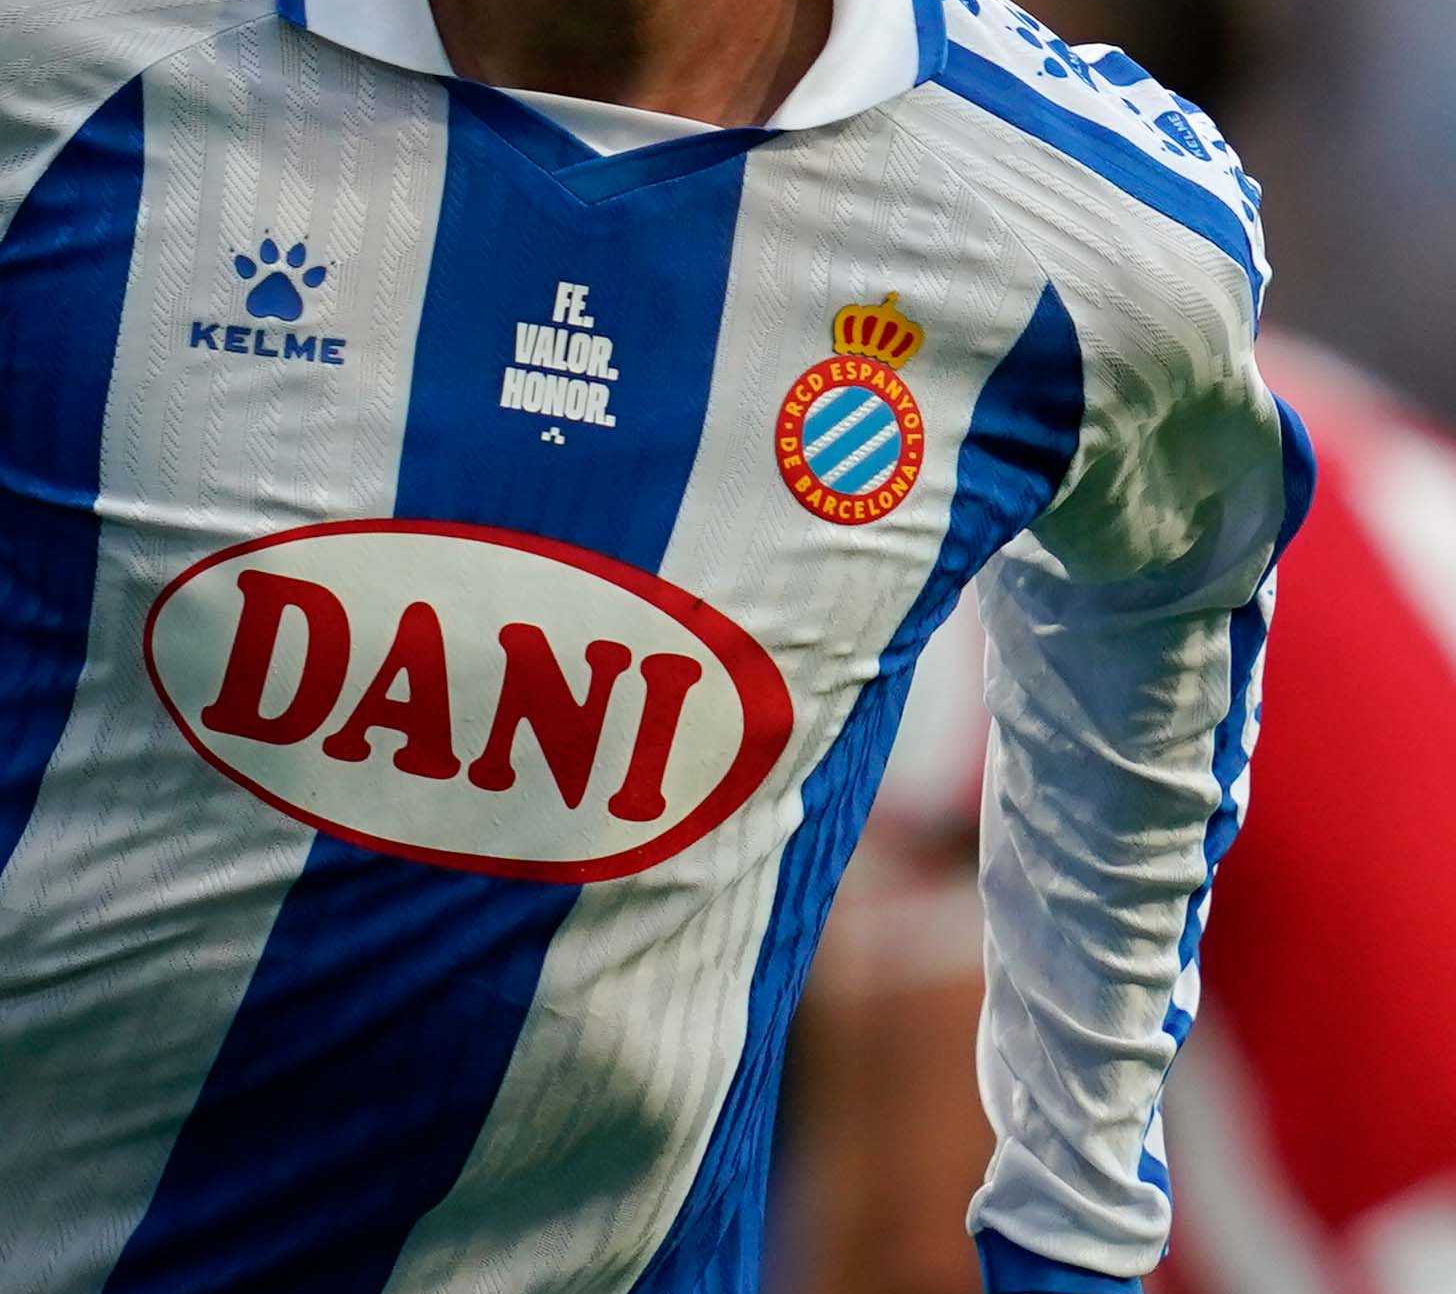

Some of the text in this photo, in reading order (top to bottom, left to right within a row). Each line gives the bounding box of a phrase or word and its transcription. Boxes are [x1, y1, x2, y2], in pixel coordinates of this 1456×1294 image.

[552, 281, 594, 328] FE.
[189, 321, 347, 365] KELME
[515, 322, 619, 381] VALOR.
[500, 367, 616, 427] HONOR.
[787, 361, 922, 446] RCD ESPANYOL
[780, 436, 918, 519] DE BARCELONA
[201, 569, 702, 822] DANI
